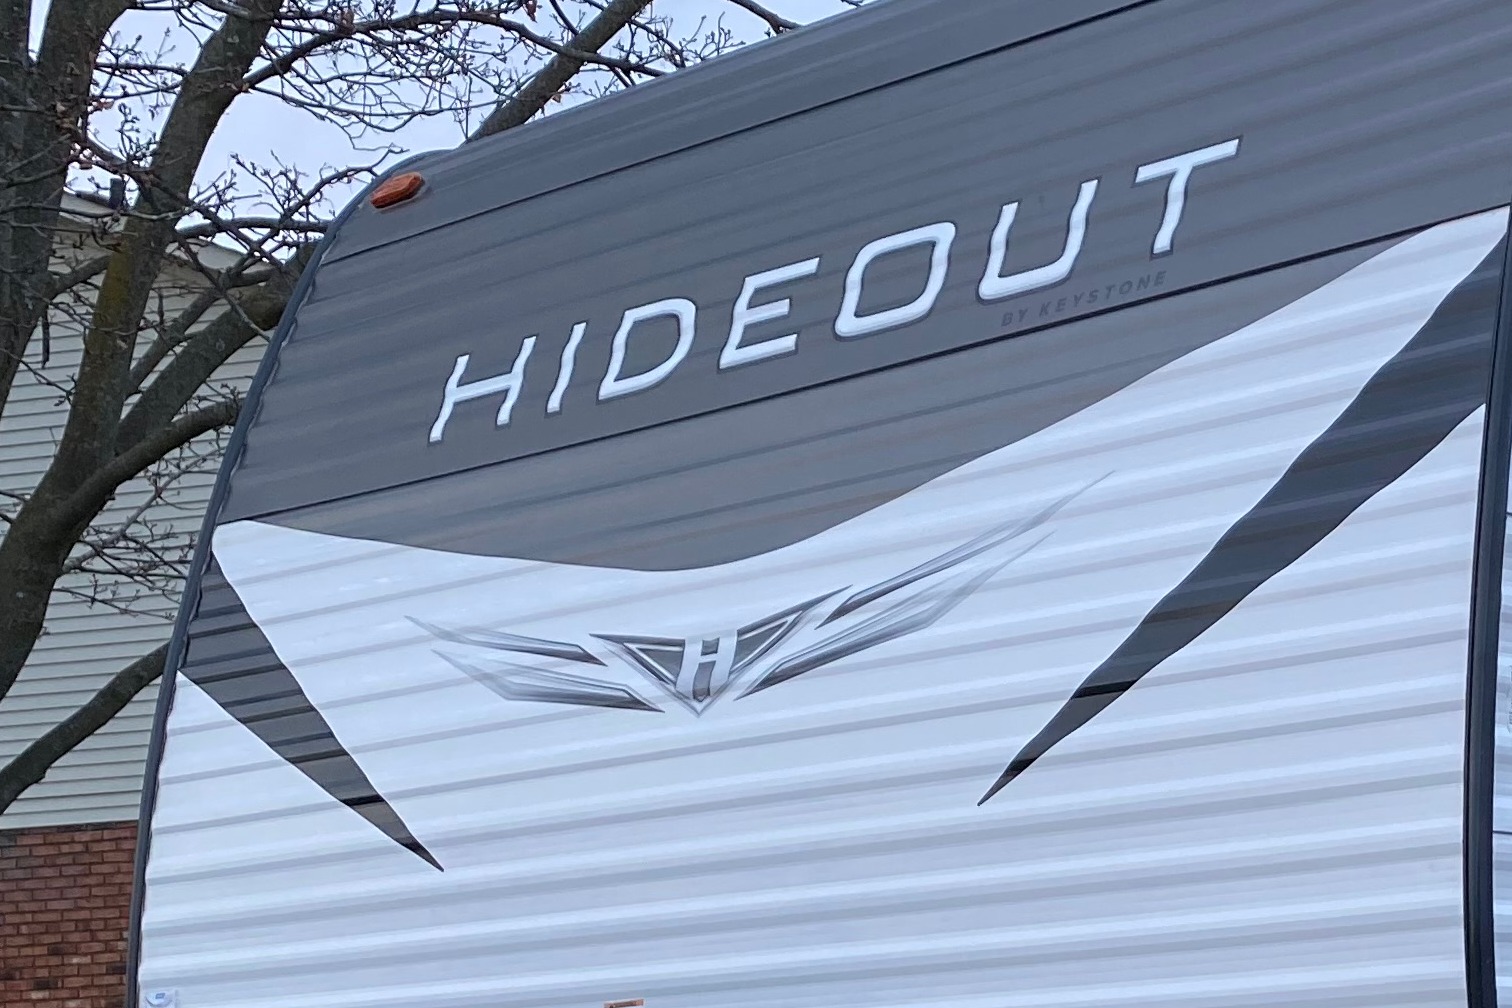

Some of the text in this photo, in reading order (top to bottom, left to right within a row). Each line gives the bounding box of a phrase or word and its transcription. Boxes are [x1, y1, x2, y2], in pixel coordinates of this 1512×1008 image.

[427, 137, 1241, 445] HIDEOUT
[1001, 270, 1167, 327] BY KEYSTONE
